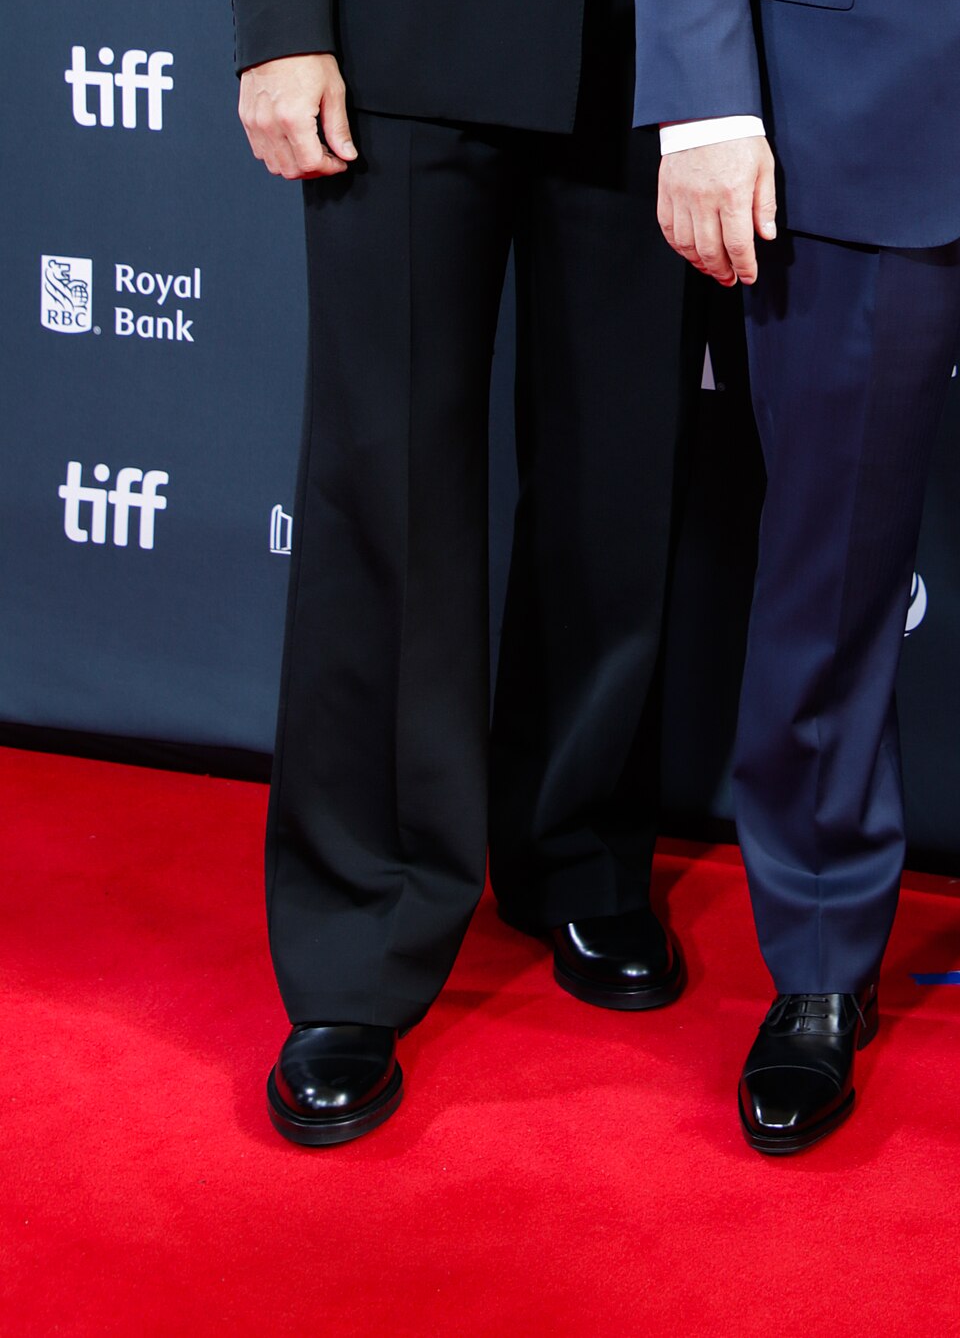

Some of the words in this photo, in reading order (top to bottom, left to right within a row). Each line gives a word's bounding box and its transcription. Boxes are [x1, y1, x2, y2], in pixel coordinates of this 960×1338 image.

[64, 45, 174, 131] tiff
[115, 263, 201, 307] Royal
[47, 309, 88, 328] RBC
[114, 307, 195, 343] Bank
[58, 460, 169, 550] tiff
